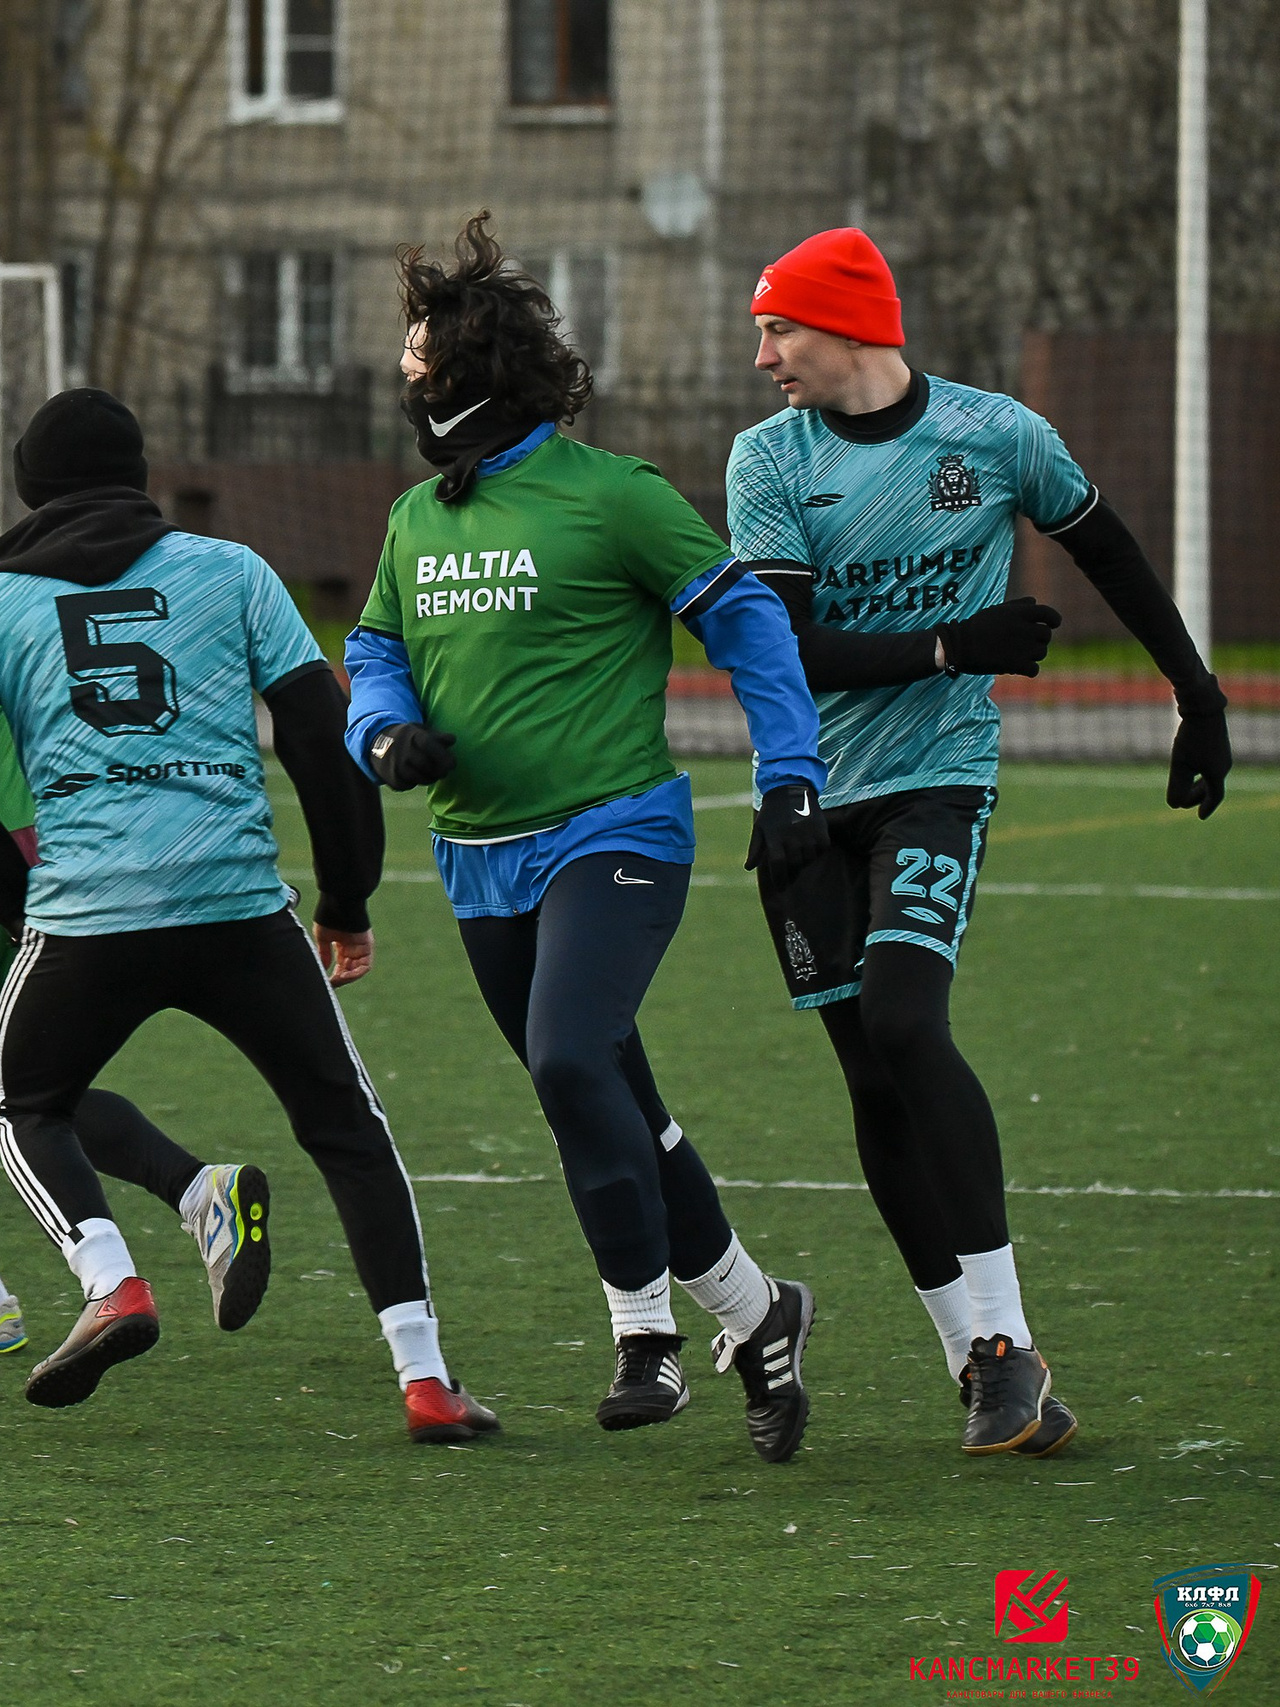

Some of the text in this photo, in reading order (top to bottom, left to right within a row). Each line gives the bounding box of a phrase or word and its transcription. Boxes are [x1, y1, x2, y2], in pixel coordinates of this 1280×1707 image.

[935, 499, 979, 509] PRIDE
[416, 548, 538, 585] BALTIA
[416, 586, 538, 618] REMONT
[823, 581, 959, 623] ATELIER
[54, 587, 179, 738] 5
[105, 759, 246, 786] SportTime
[890, 847, 963, 912] 22
